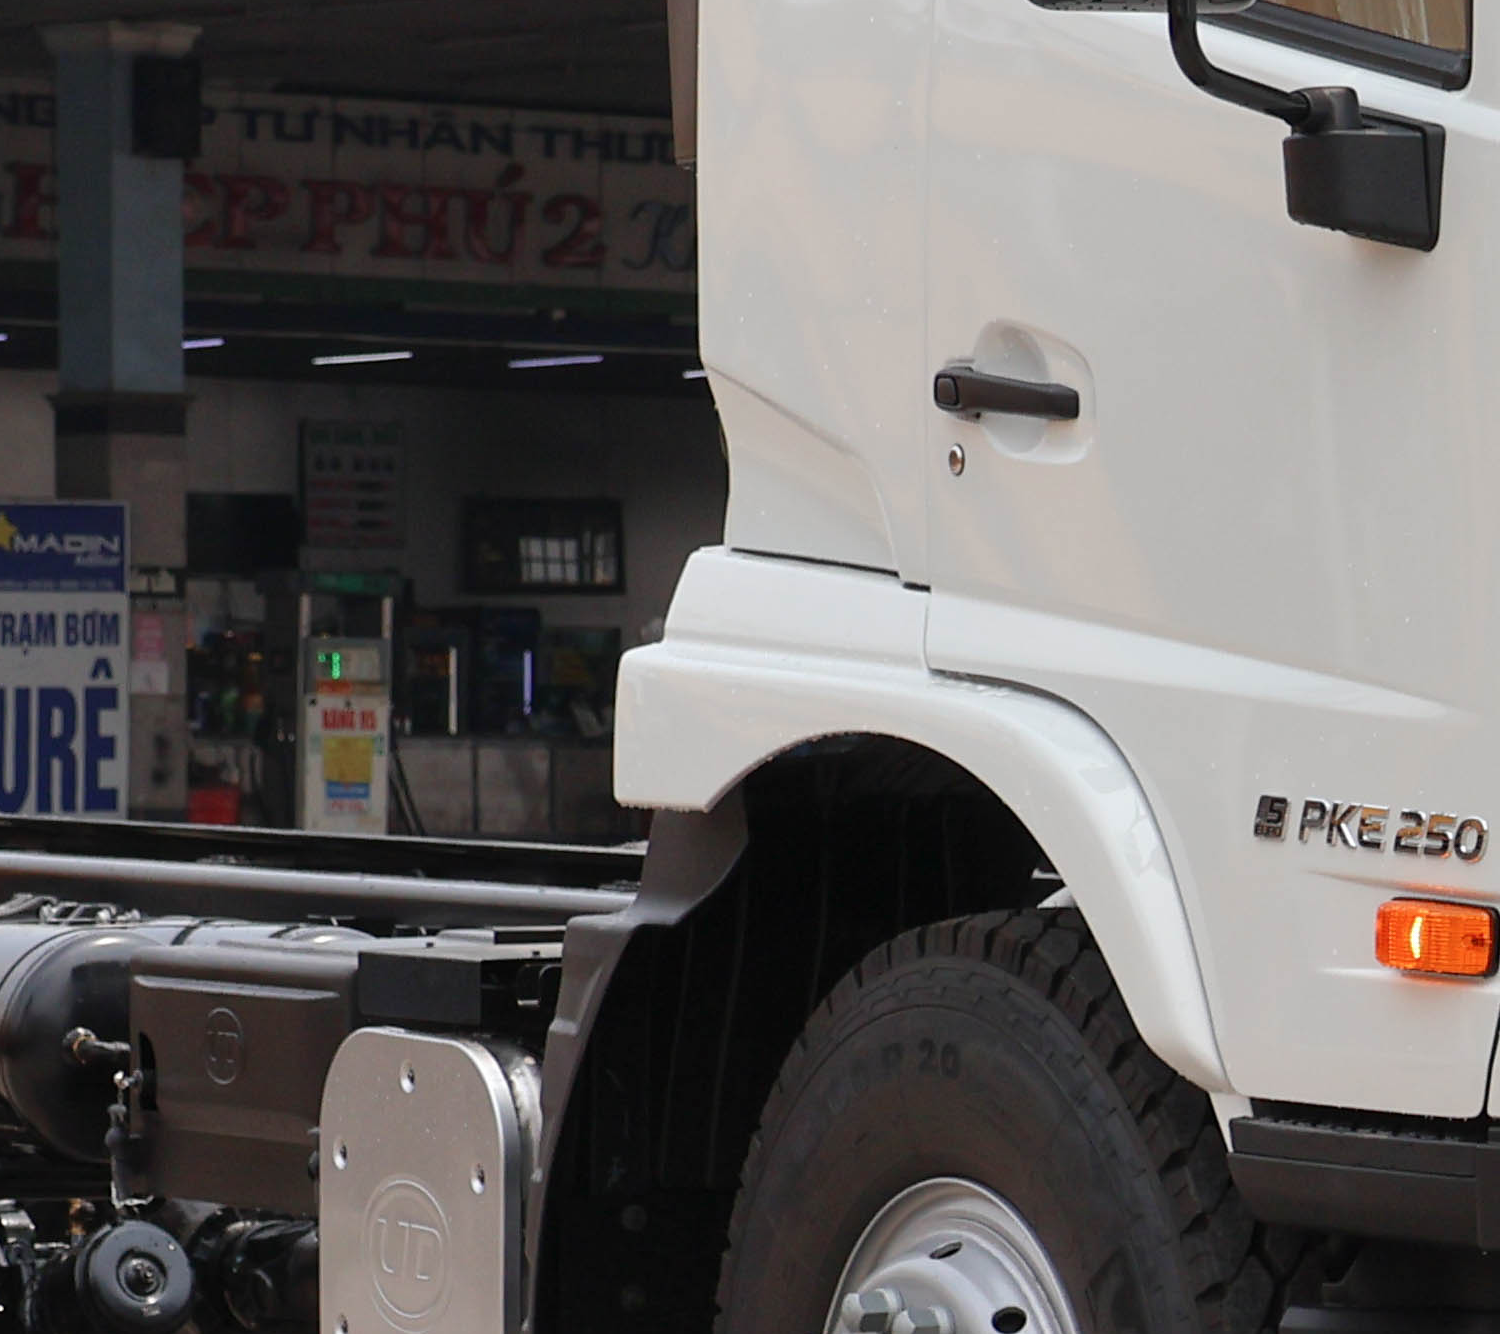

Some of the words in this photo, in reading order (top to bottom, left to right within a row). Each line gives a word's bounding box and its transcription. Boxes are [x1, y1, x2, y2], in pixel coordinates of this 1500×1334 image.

[302, 164, 532, 263] PHÚ
[543, 193, 606, 267] 2
[65, 609, 120, 646] BƠM
[1299, 797, 1389, 849] PKE
[1394, 810, 1489, 864] 250
